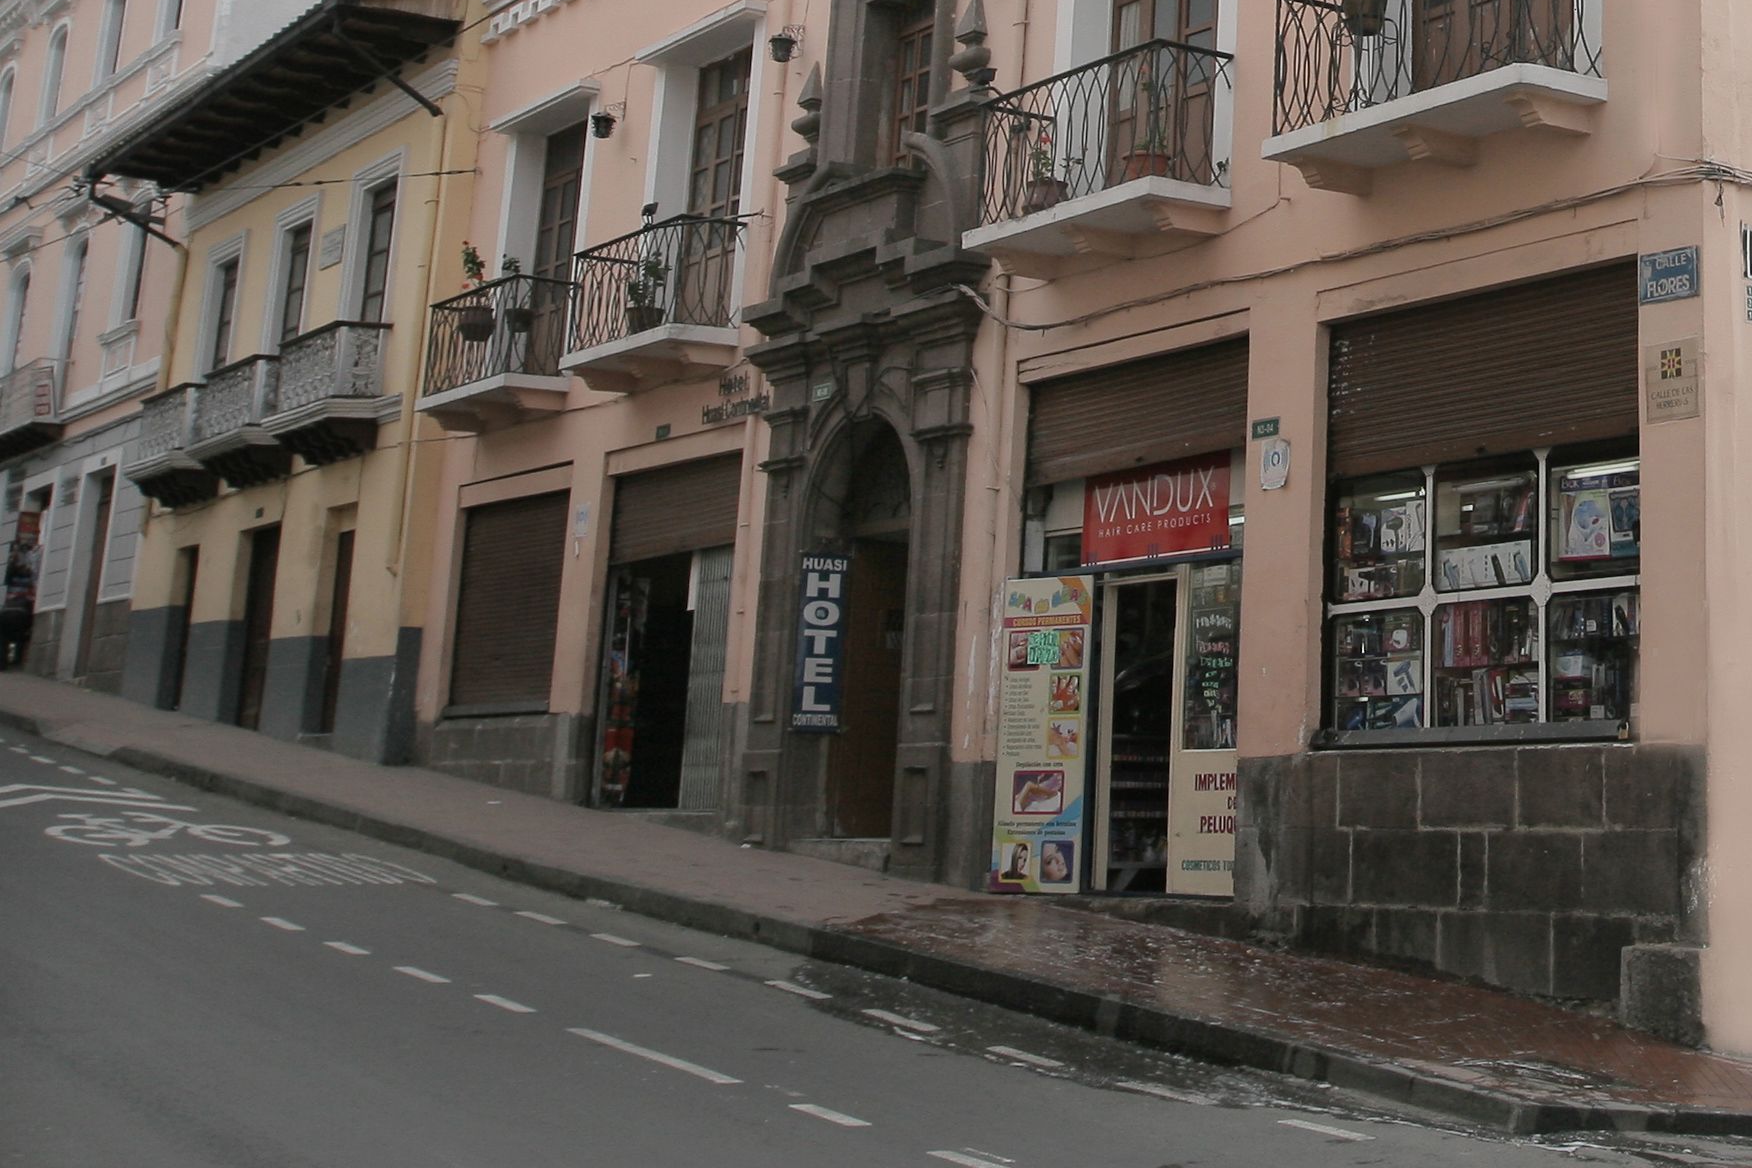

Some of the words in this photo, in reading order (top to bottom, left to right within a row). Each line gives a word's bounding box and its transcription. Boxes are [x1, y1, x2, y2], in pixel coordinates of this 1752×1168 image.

[1655, 253, 1687, 270] CALLE
[1647, 275, 1690, 298] FLORES
[719, 370, 748, 396] Hotel
[1095, 465, 1214, 523] VANDUX
[1099, 526, 1121, 538] HAIR
[1126, 521, 1152, 535] CARE
[1157, 513, 1211, 529] PRODUCTS
[802, 557, 848, 571] HUASI
[802, 572, 842, 712] HOTEL
[792, 714, 838, 726] CONTINENTAL
[98, 853, 437, 886] COMPARTIDO
[1182, 859, 1220, 871] COSMETICOS
